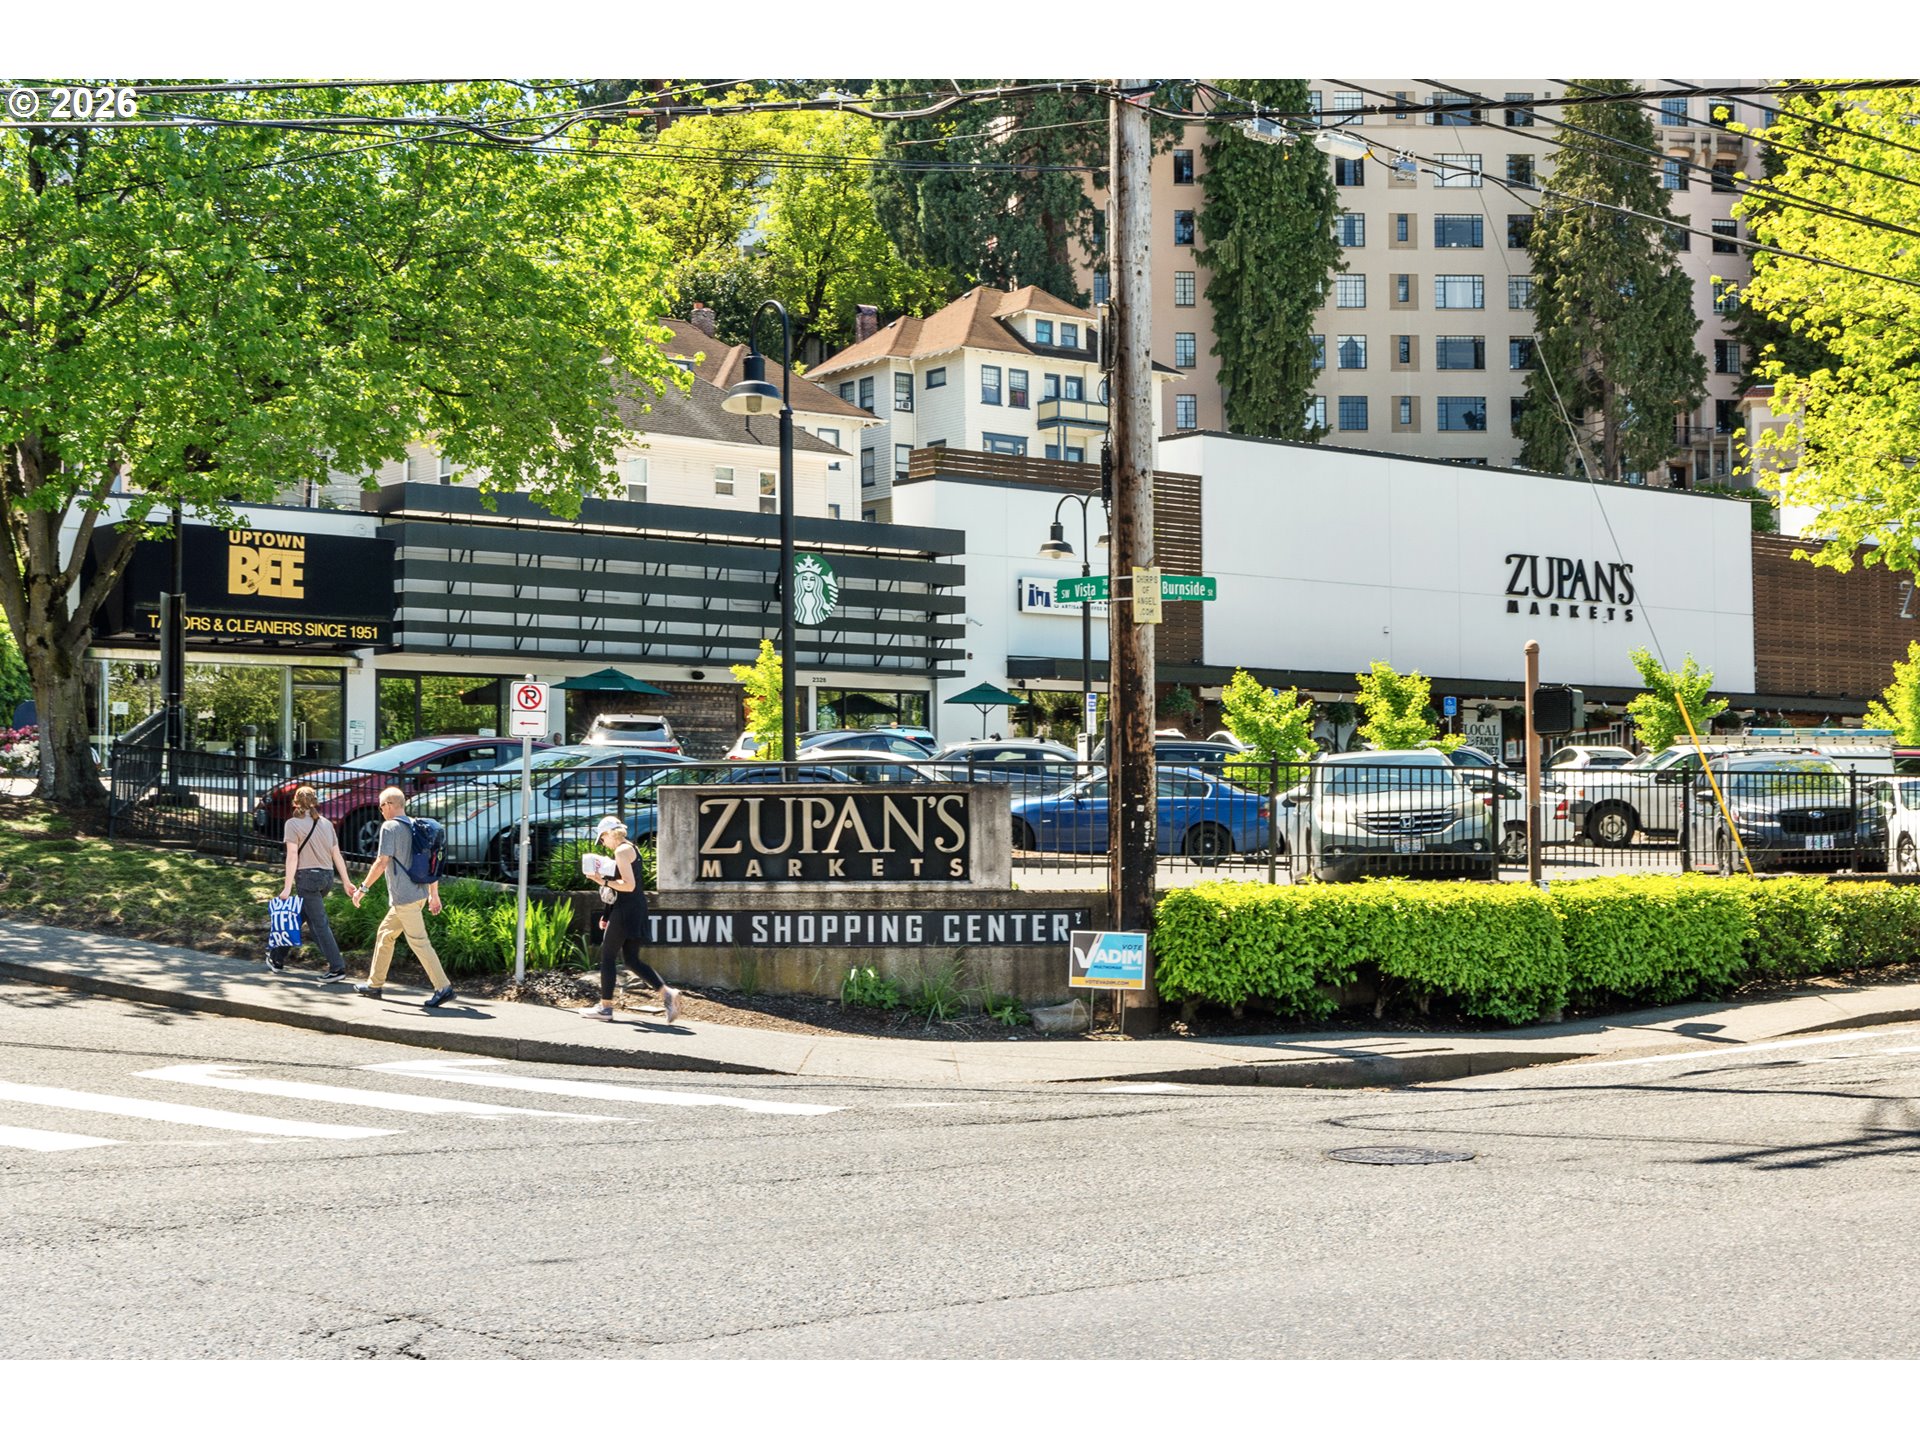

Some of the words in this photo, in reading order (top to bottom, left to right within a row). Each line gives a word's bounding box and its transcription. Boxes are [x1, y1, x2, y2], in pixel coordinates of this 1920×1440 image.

[228, 530, 305, 549] UPTOWN
[228, 545, 305, 599] BEE
[1505, 553, 1635, 606] ZUPAN'S
[1061, 590, 1071, 599] SW
[1074, 583, 1096, 598] Vista
[1162, 581, 1206, 596] Burnside
[1506, 600, 1634, 622] MARKETS
[214, 618, 225, 631] &
[226, 618, 302, 635] CLEANERS
[305, 622, 347, 638] SINCE
[350, 625, 378, 640] 1951
[1464, 724, 1499, 736] LOCAL
[700, 794, 967, 855] ZUPAN'S
[702, 857, 963, 877] MARKETS
[648, 914, 734, 942] TOWN
[752, 914, 923, 943] SHOPPING
[943, 914, 1070, 942] CENTER
[1073, 940, 1143, 968] VADIM
